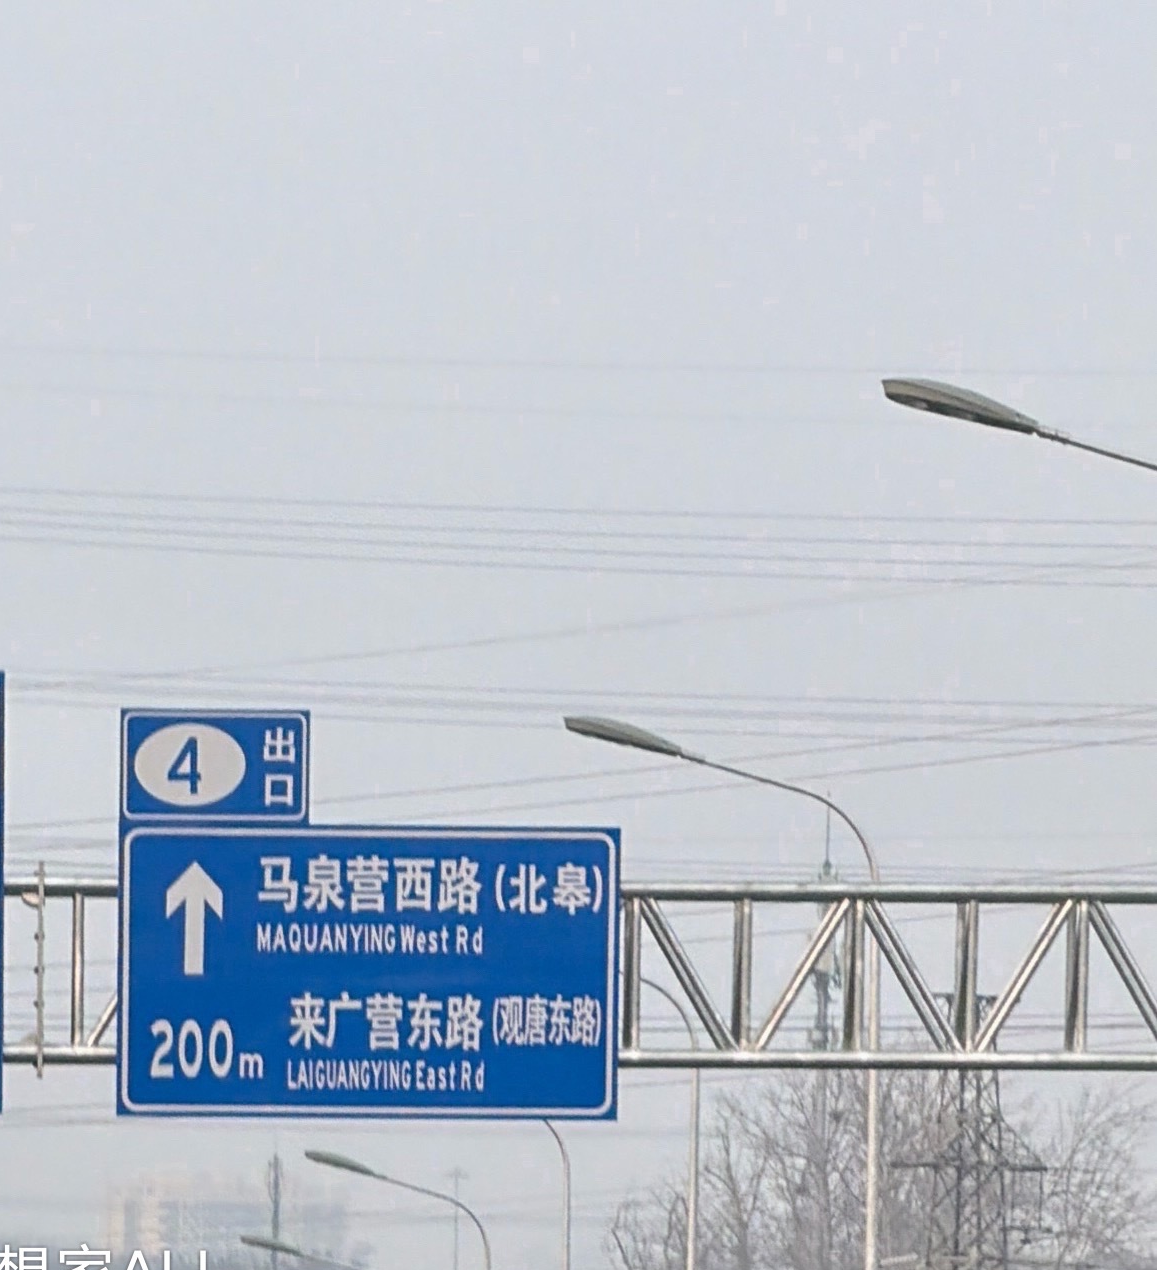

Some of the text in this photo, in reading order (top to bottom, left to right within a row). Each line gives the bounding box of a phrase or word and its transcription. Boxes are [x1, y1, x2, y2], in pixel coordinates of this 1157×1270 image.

[167, 736, 202, 795] 4
[263, 726, 297, 807] 出口
[257, 923, 484, 955] MAQUANYING West Rd
[287, 1059, 485, 1092] LAIGUANGYING East Rd
